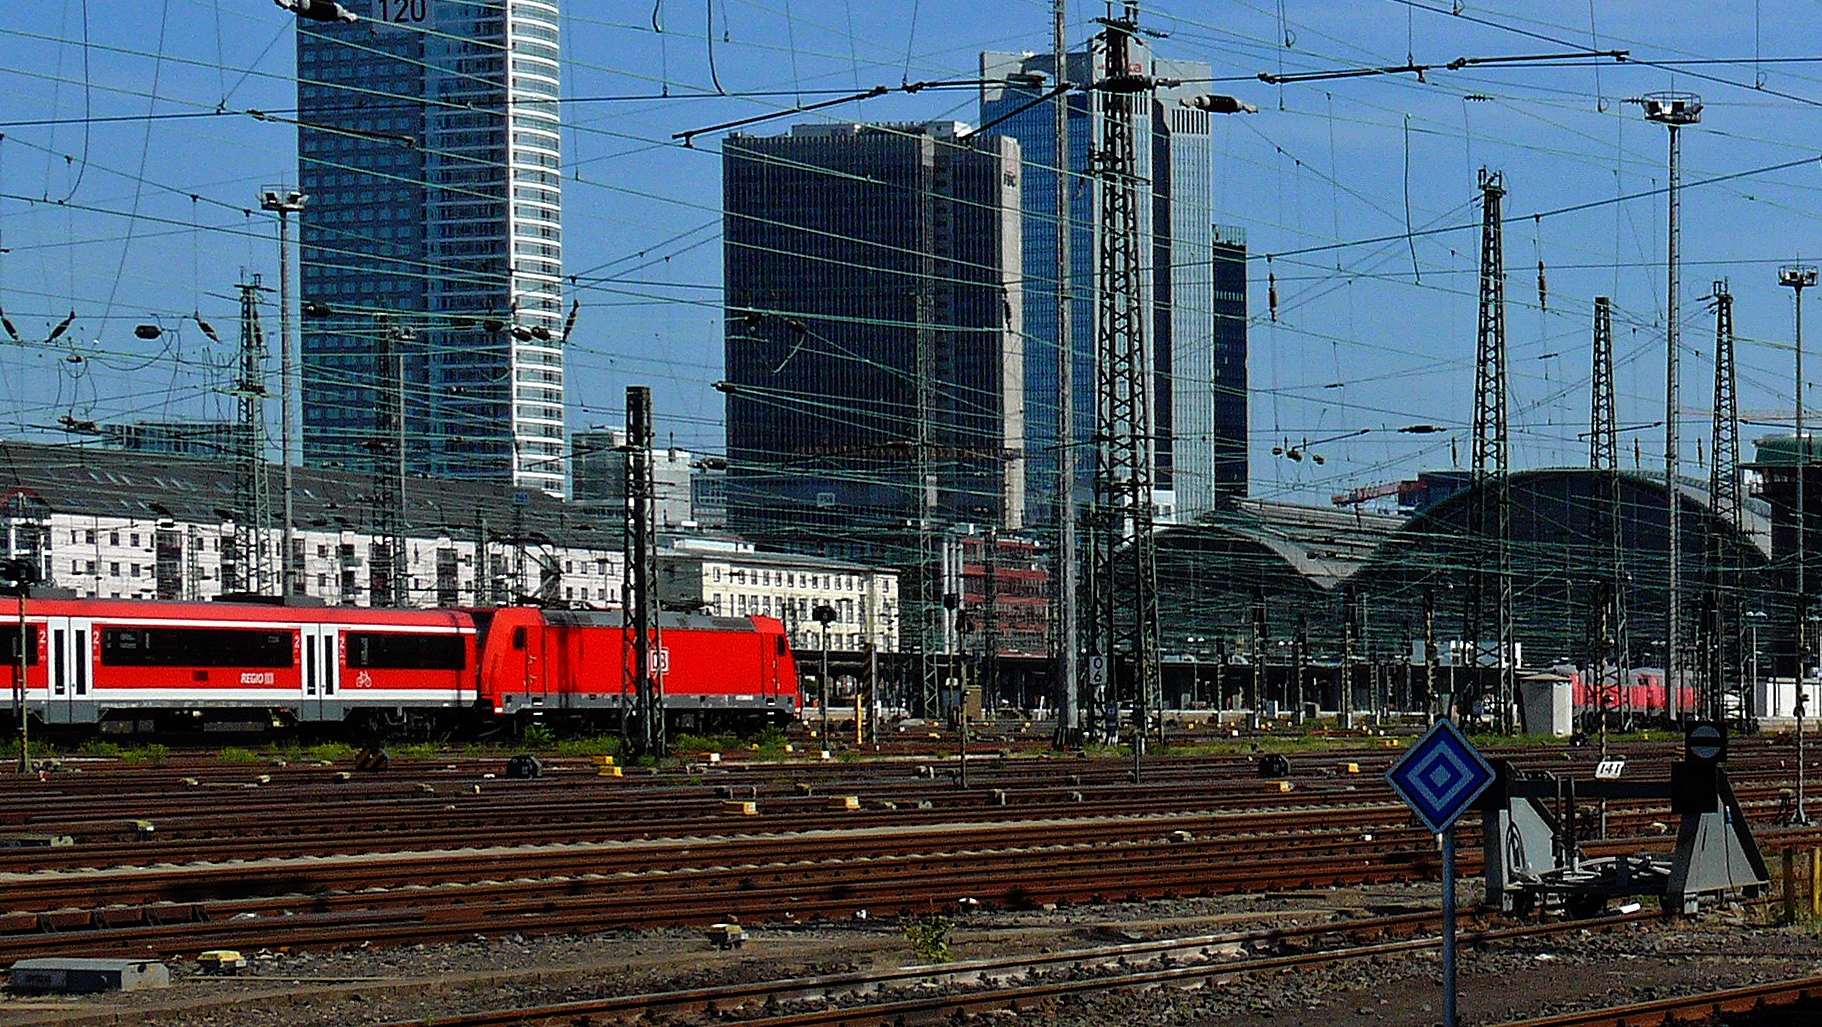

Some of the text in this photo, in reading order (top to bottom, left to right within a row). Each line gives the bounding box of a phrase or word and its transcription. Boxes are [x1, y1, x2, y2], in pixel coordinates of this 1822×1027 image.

[38, 632, 47, 643] 2
[93, 631, 100, 644] 2
[240, 673, 263, 684] REGIO
